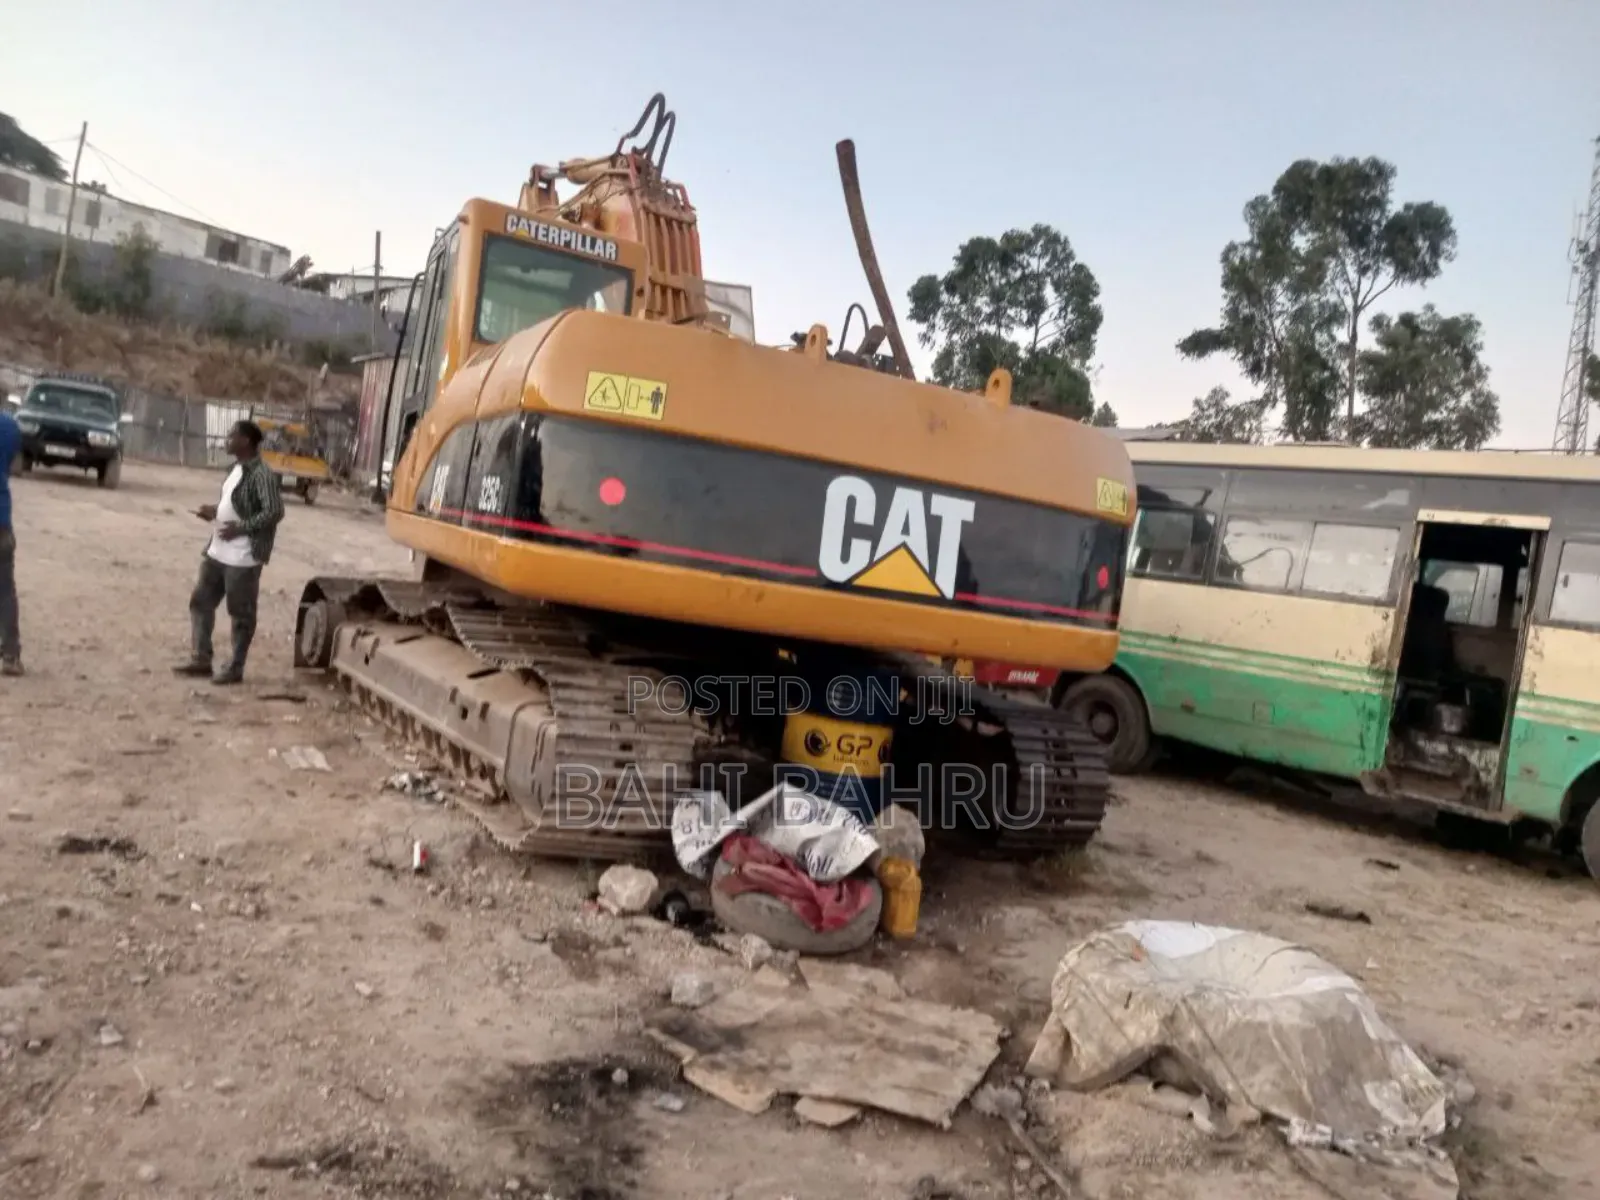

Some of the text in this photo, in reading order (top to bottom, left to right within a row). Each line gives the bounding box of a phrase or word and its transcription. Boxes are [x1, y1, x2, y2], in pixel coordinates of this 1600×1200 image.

[506, 213, 618, 261] CATERPILLAR
[818, 475, 976, 600] CAT
[836, 733, 874, 757] GP
